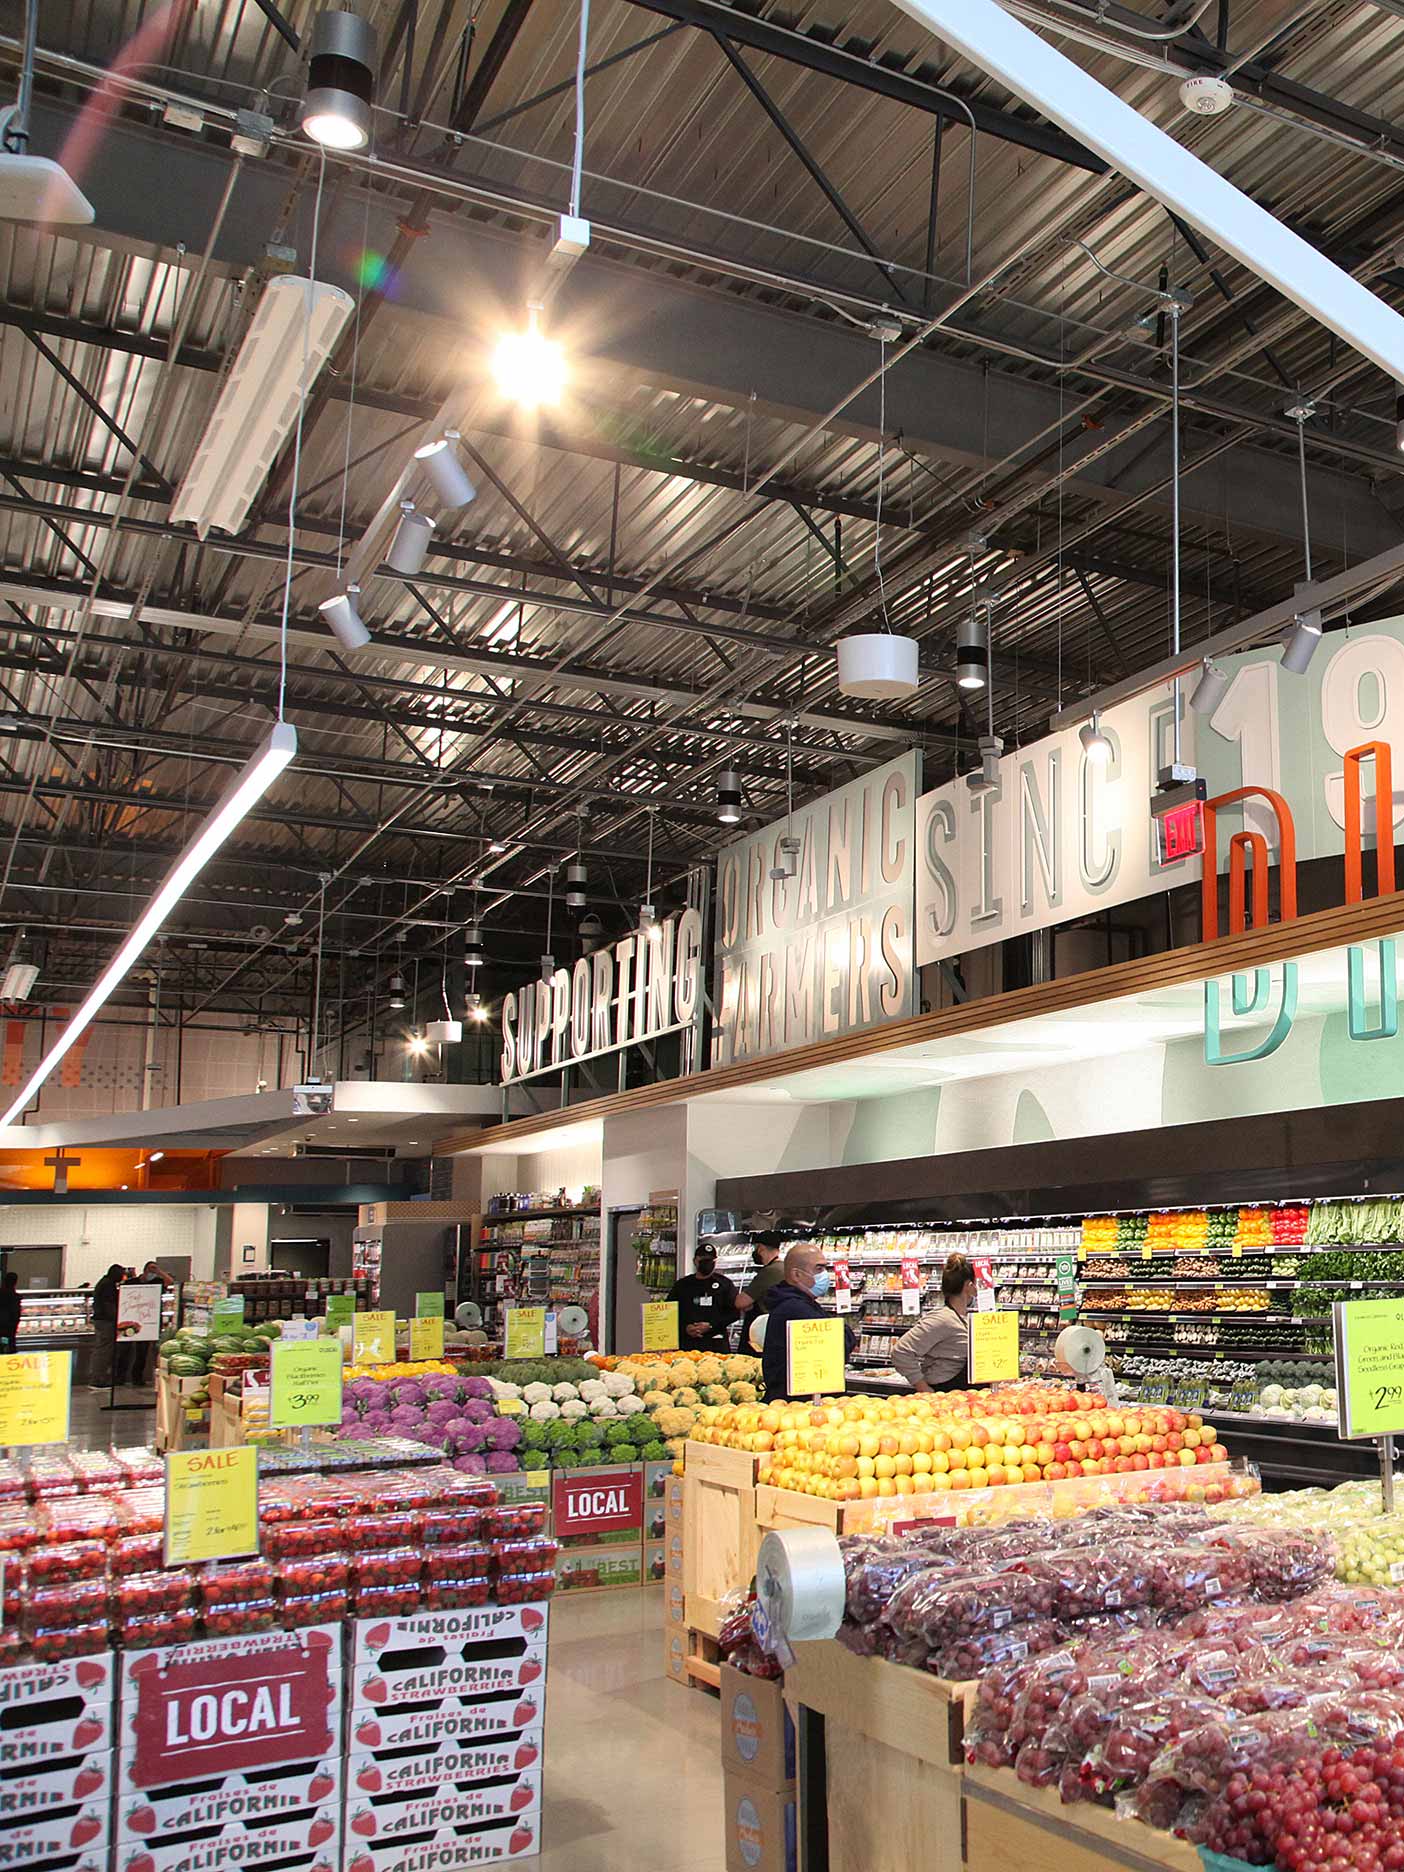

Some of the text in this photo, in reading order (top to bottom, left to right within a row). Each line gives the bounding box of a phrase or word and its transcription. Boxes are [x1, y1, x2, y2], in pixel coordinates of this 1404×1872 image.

[926, 693, 1187, 937] SINCE
[722, 770, 907, 949] ORGANIC
[712, 904, 905, 1062] FARMERS
[501, 908, 701, 1082] SUPPORTING
[363, 1313, 386, 1322] SALE
[517, 1310, 536, 1318] SALE
[982, 1313, 1008, 1325] SALE
[802, 1321, 832, 1334] SALE
[1363, 1343, 1404, 1354] Organic Red
[187, 1450, 240, 1472] SALE
[568, 1489, 630, 1518] LOCAL
[597, 1559, 638, 1572] BEST
[418, 1629, 495, 1644] Fraises de
[391, 1667, 514, 1692] CALIFORNIA
[391, 1679, 514, 1701] STRAWBERRIES
[166, 1682, 302, 1746] LOCAL
[409, 1706, 487, 1724] Fraises de
[386, 1764, 510, 1790] STRAWBERRIES
[387, 1752, 510, 1780] CALIFORNIA
[189, 1783, 277, 1805] Fraises de
[405, 1792, 483, 1811] Fraises de
[189, 1829, 277, 1852] Fraises de
[404, 1836, 481, 1855] Fraises de
